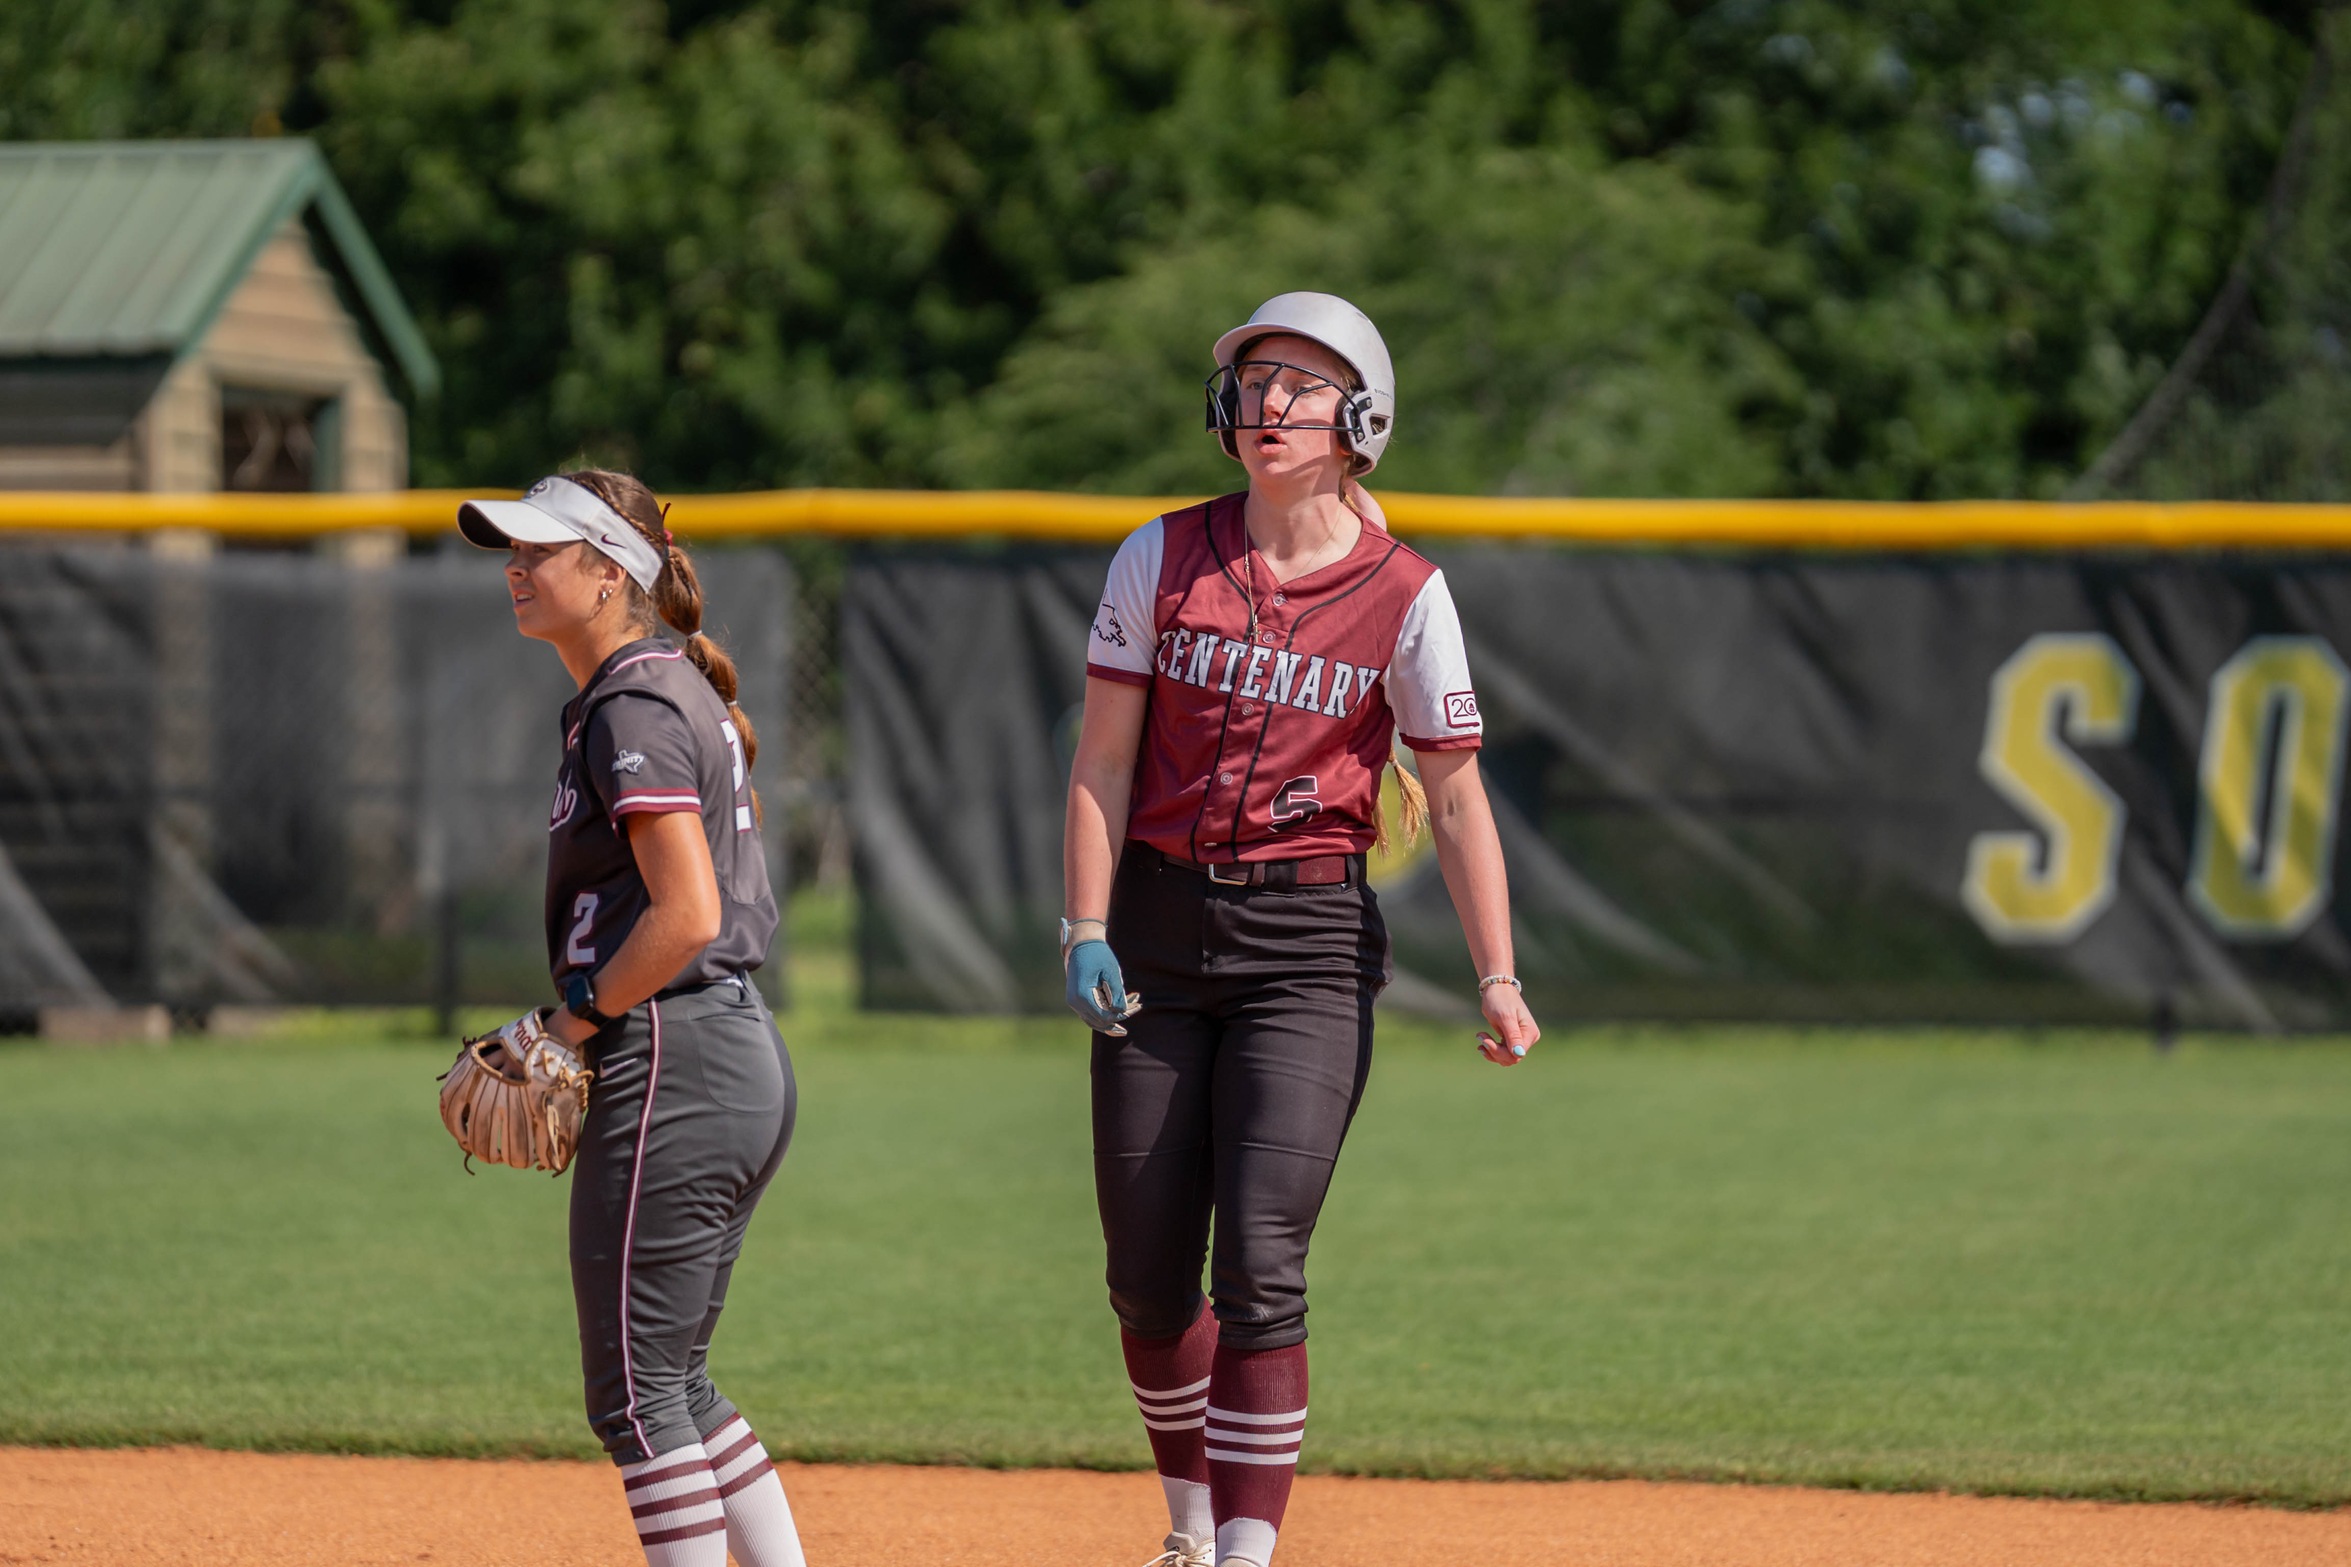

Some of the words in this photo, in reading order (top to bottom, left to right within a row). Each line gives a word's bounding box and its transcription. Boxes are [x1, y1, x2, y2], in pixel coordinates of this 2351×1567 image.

[1157, 627, 1381, 719] CENTENARY
[1267, 775, 1323, 833] 5
[1960, 631, 2351, 946] SO
[567, 892, 599, 965] 2
